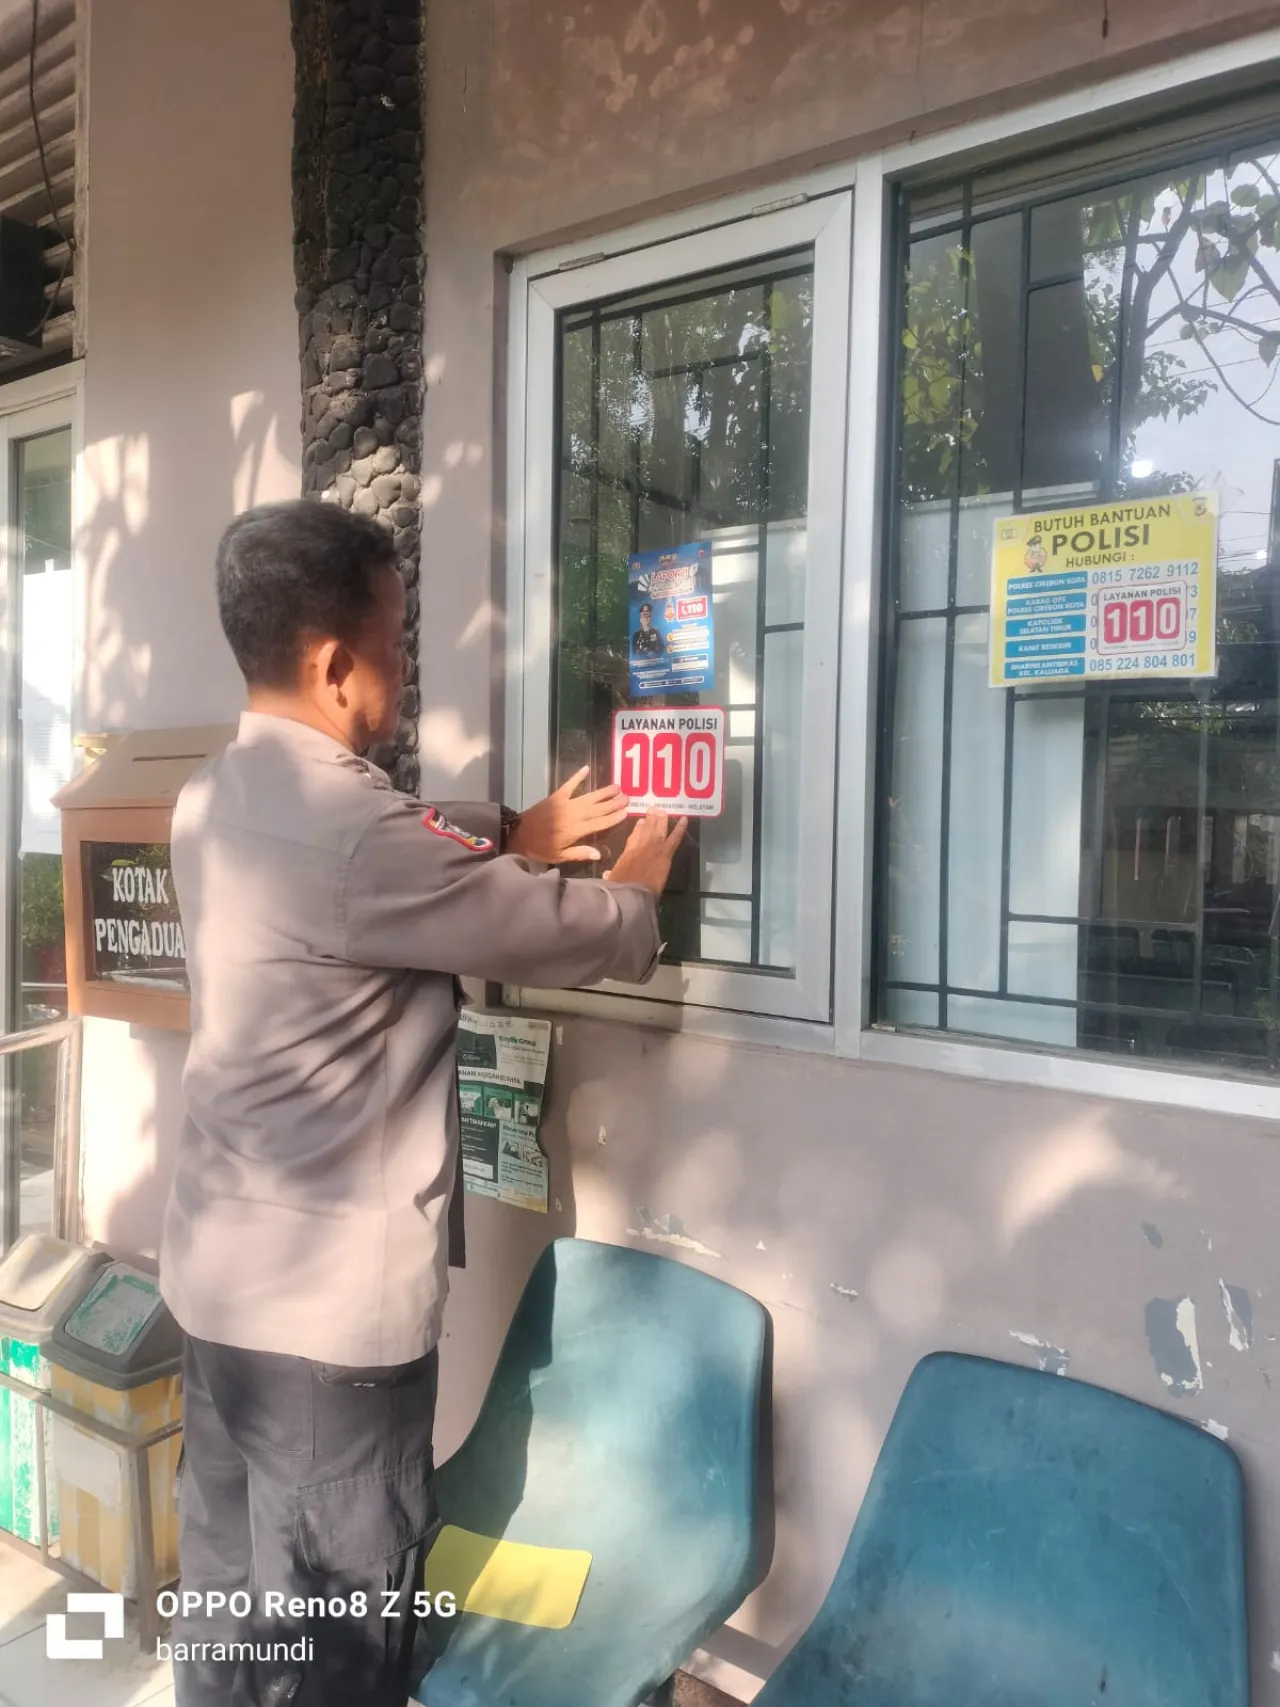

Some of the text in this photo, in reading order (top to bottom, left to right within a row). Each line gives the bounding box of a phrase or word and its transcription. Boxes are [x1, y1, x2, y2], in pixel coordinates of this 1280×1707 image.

[1034, 504, 1171, 533] BUTUH BANTUAN
[1052, 524, 1150, 556] POLISI
[1066, 552, 1127, 568] HUBUNGI
[1092, 562, 1198, 585] 0815 7262 9112
[1103, 590, 1147, 601] LAYANAN
[1150, 586, 1182, 597] POLISI
[1107, 602, 1177, 638] 110
[1089, 653, 1195, 672] 085 224 804 801
[621, 717, 718, 730] LAYANAN POLISI
[625, 741, 711, 791] 110
[112, 866, 169, 904] KOTAK
